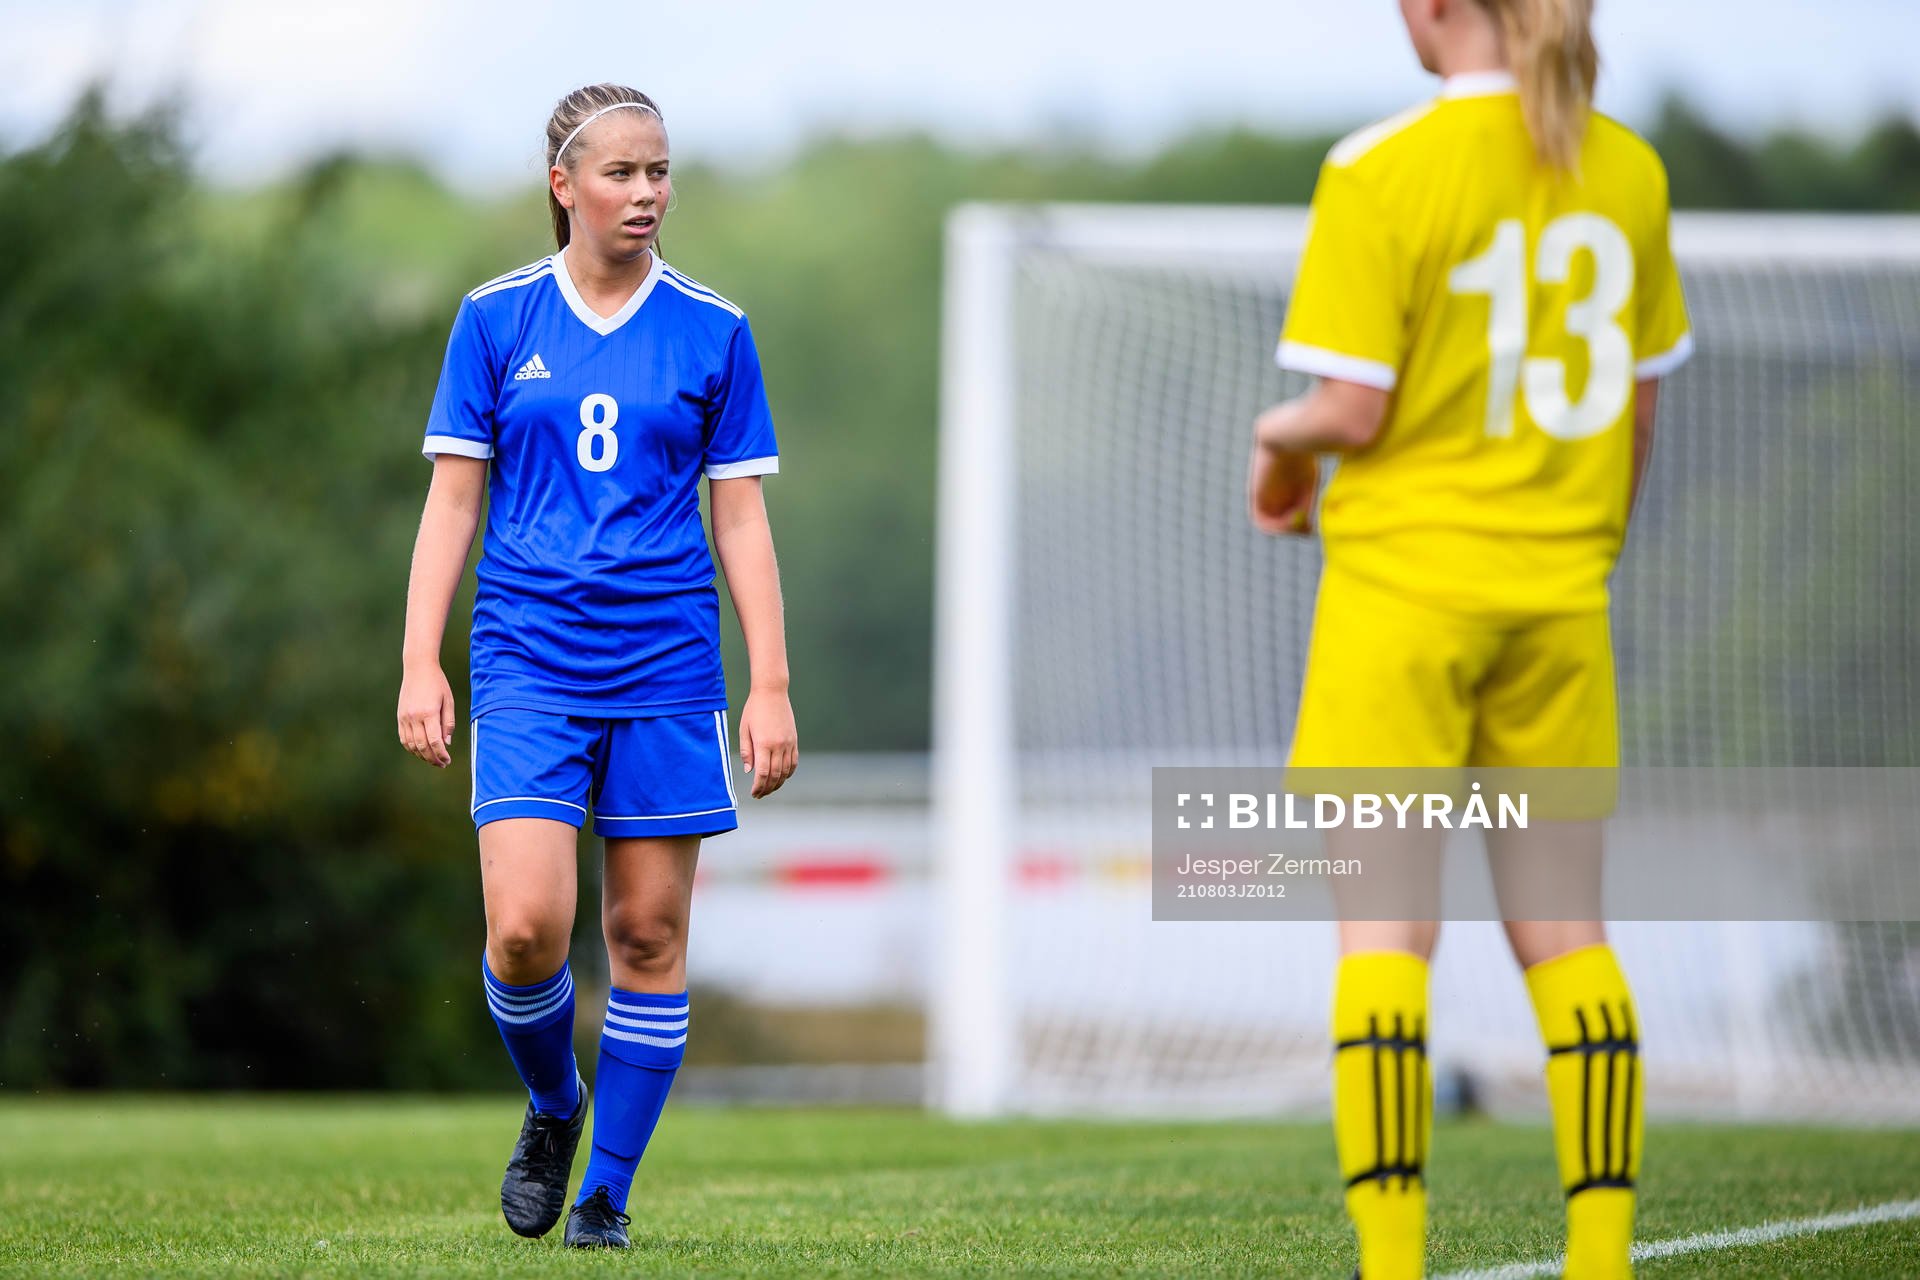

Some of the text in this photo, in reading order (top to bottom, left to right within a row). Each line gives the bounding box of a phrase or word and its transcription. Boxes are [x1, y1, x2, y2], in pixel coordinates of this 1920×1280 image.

[1447, 211, 1635, 440] 13
[514, 370, 551, 381] adidas
[577, 393, 619, 472] 8
